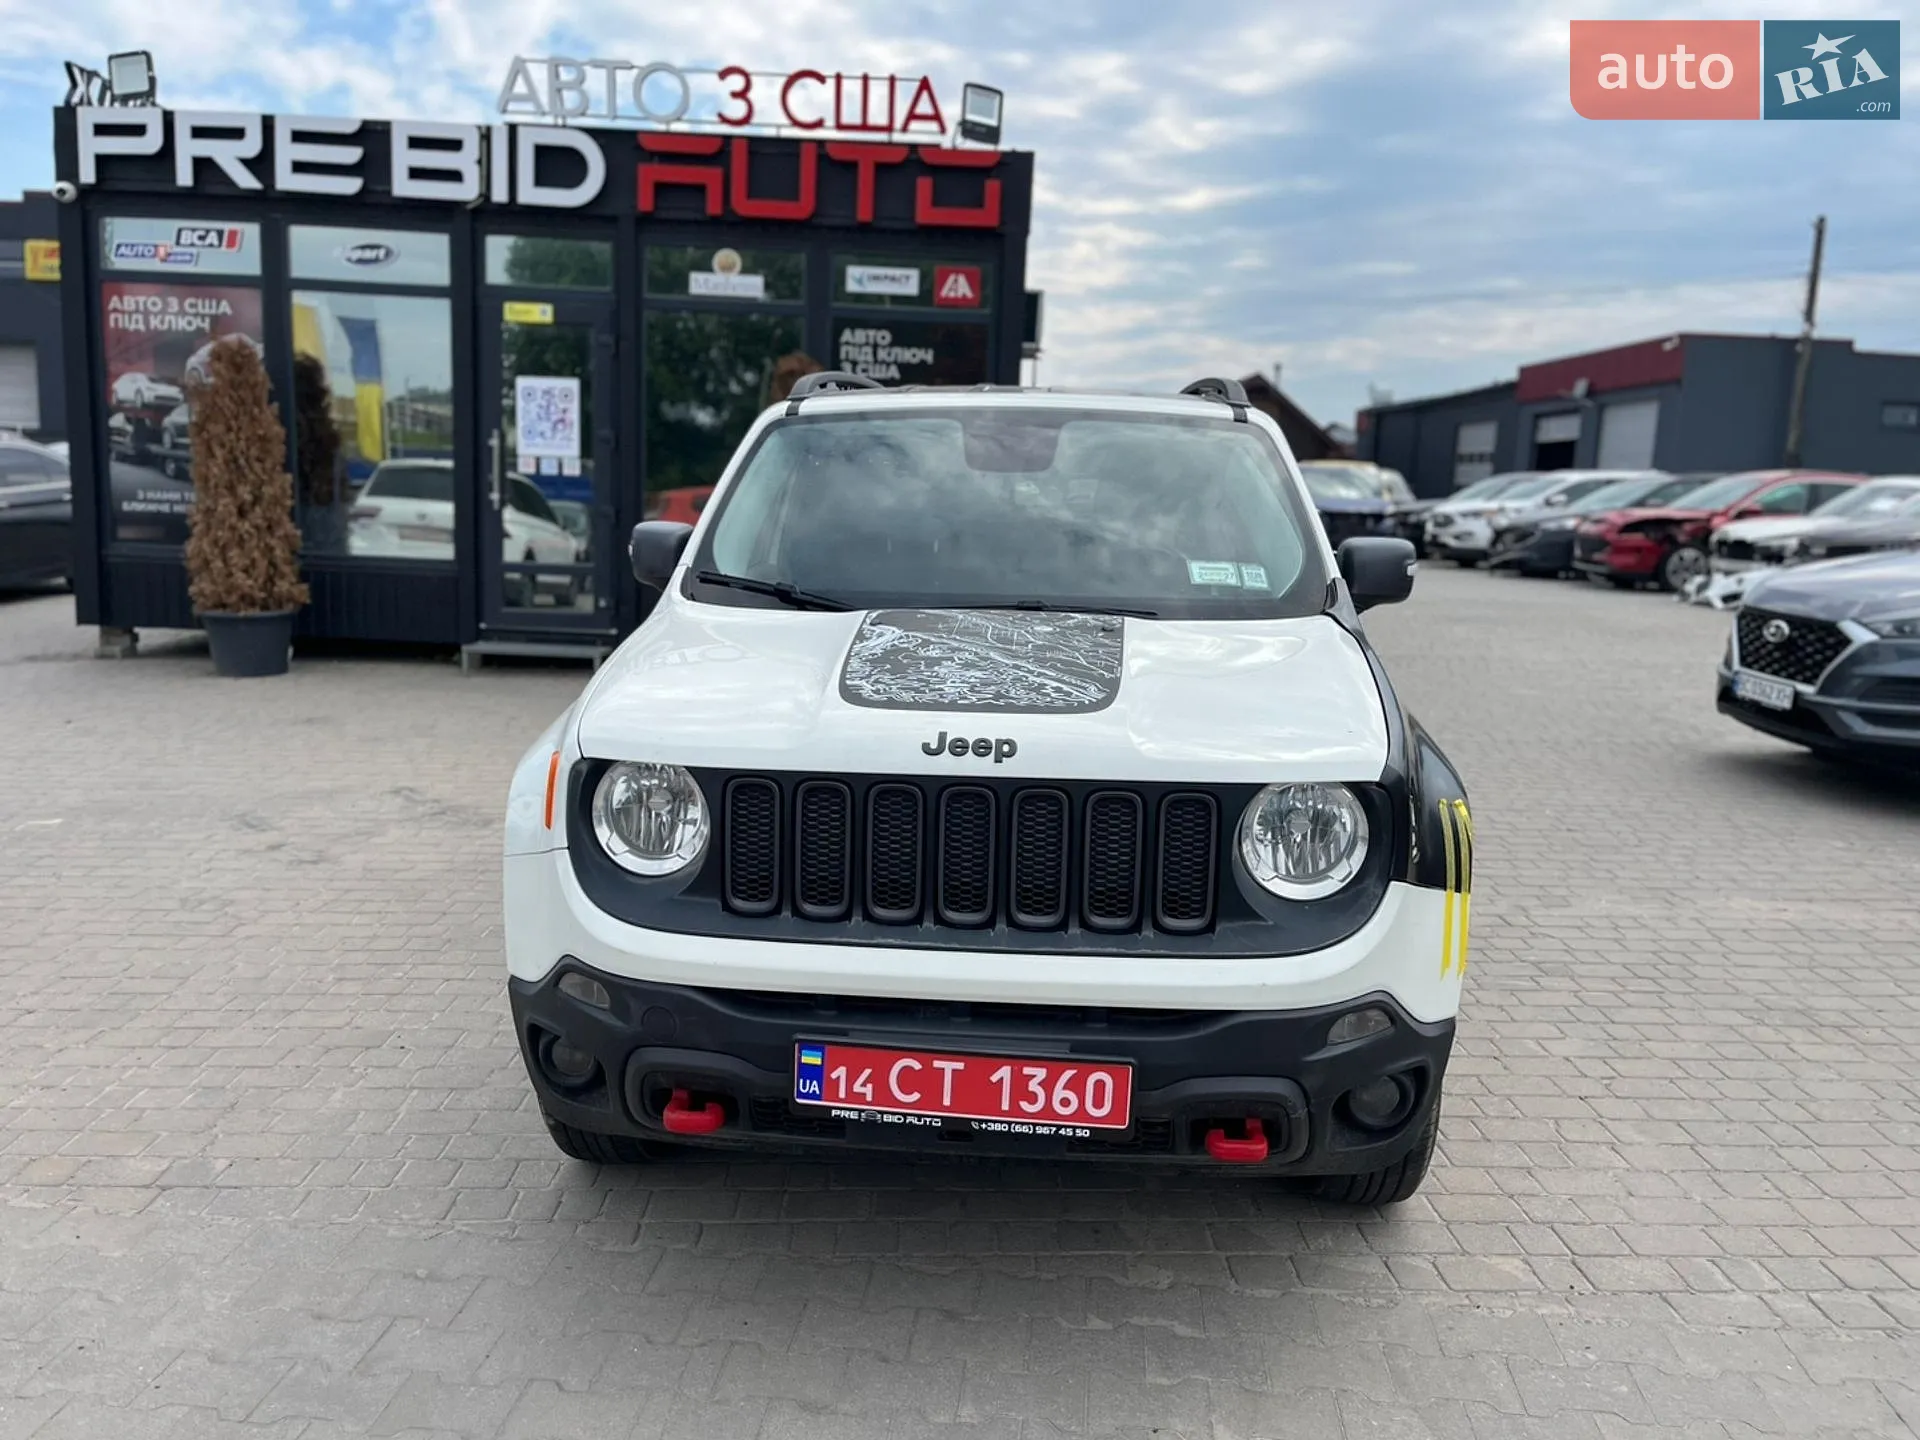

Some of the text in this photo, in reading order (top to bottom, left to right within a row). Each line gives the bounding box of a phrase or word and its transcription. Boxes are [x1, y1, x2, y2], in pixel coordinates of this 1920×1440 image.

[498, 55, 690, 123] АВТО
[780, 69, 946, 133] США
[637, 132, 1001, 227] AUTO
[179, 229, 219, 247] BCA
[108, 295, 162, 312] АВТО
[183, 297, 232, 315] США
[109, 312, 211, 332] ПІД КЛЮЧ
[839, 328, 893, 346] АВТО
[839, 344, 934, 365] ПІД КЛЮЧ
[855, 362, 901, 380] США
[921, 731, 1018, 763] Jeep
[799, 1058, 1114, 1118] UA 14 CT 1360
[831, 1109, 859, 1120] PRE
[883, 1113, 904, 1123] BID
[905, 1115, 942, 1127] AUTO
[980, 1122, 1009, 1132] +380
[1010, 1123, 1033, 1134] (66)
[1058, 1127, 1073, 1136] 45
[1075, 1128, 1091, 1138] 50
